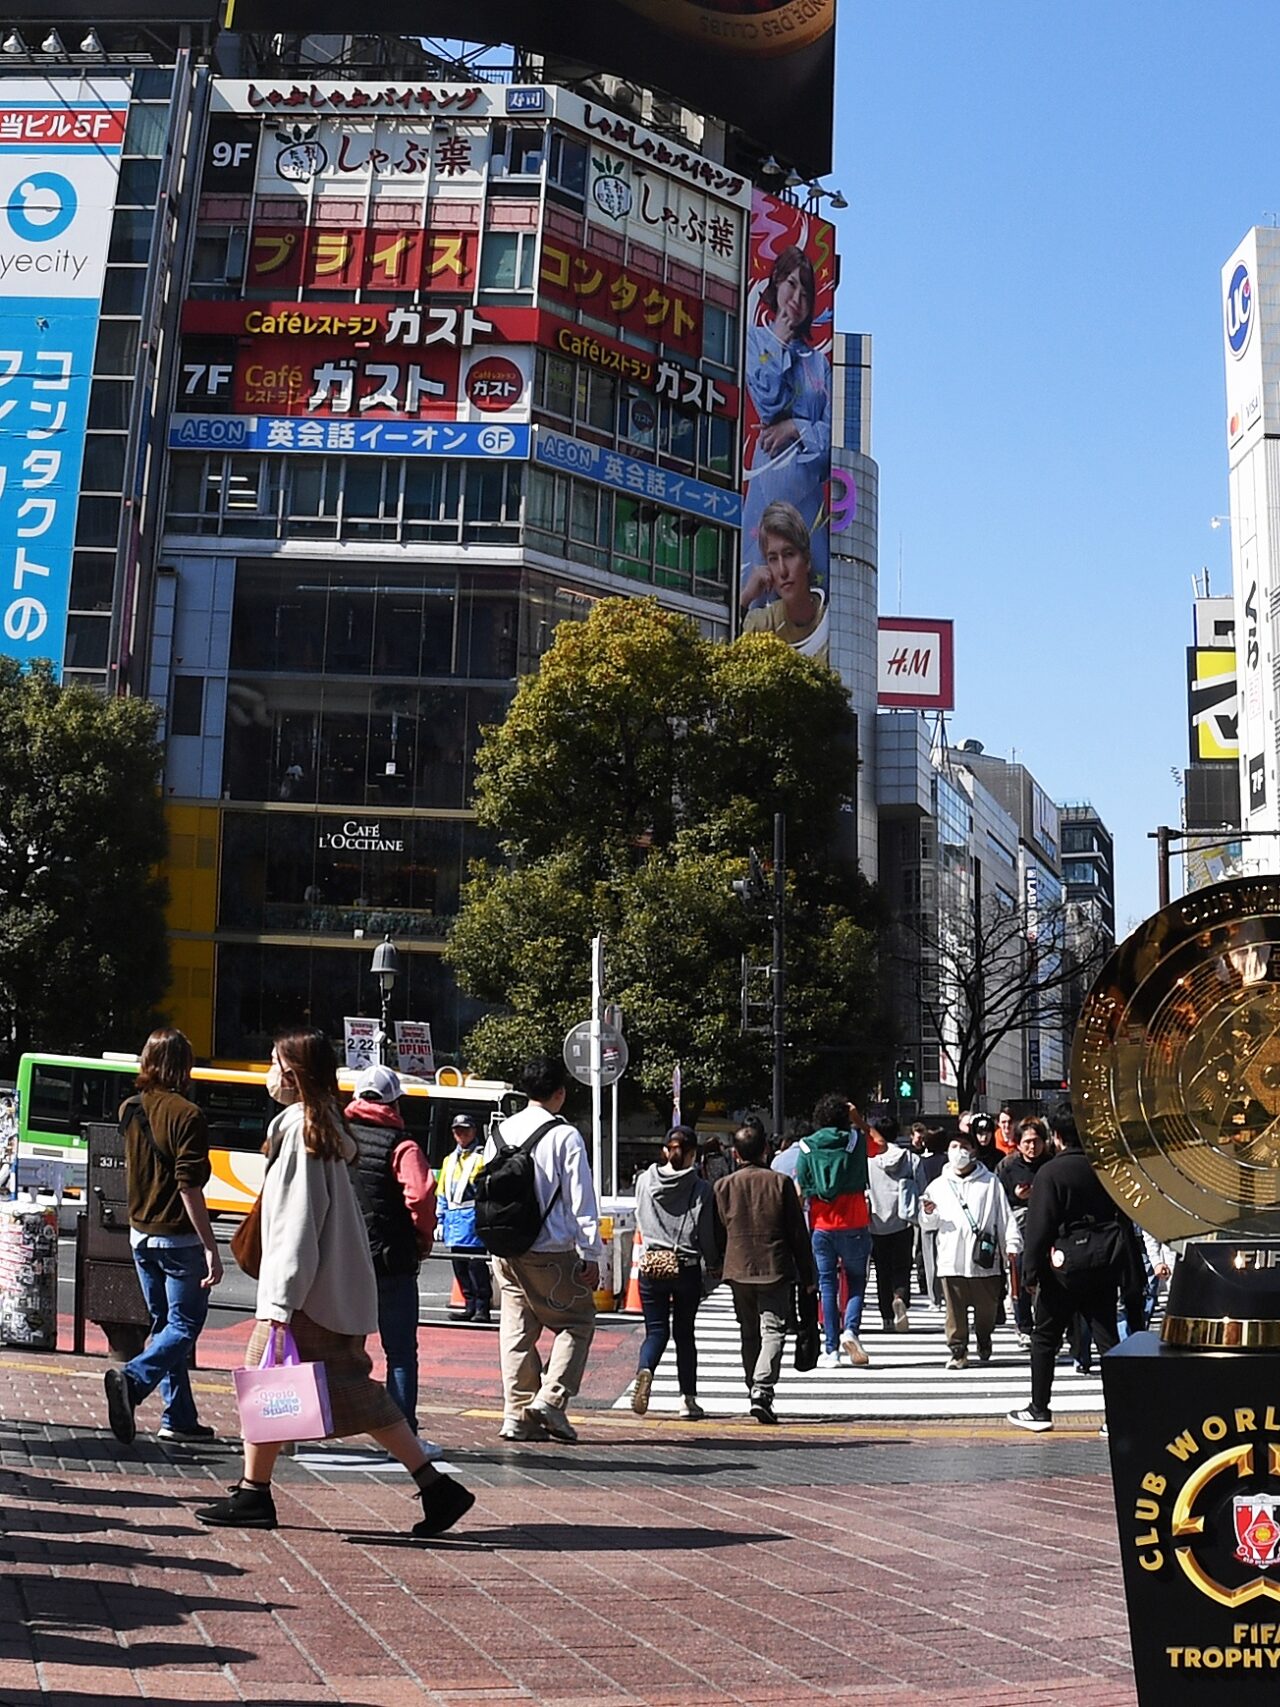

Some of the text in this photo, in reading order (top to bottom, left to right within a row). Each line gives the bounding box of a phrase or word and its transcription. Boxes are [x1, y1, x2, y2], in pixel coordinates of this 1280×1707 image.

[247, 85, 482, 109] しゃぶしゃぶバイキング
[509, 90, 541, 110] 寿司
[0, 112, 111, 139] 当ビル5F
[212, 142, 252, 166] 9F
[338, 136, 472, 176] しゃぶ葉
[584, 105, 744, 196] しゃぶしゃぶバイキング
[642, 183, 735, 257] しゃぶ葉
[254, 234, 469, 277] プライス
[542, 245, 695, 338] コンタクト
[386, 306, 492, 346] ガスト
[184, 365, 233, 394] 7F
[245, 365, 303, 389] Café
[308, 358, 445, 413] ガスト
[473, 381, 517, 396] ガスト
[656, 362, 726, 413] ガスト
[180, 419, 510, 449] AEON 英会話イーオン 6F
[4, 352, 73, 641] コンタクトの
[544, 436, 741, 520] AEON 英会話イーオン
[887, 648, 931, 678] H&M
[1134, 1471, 1168, 1572] CLUB
